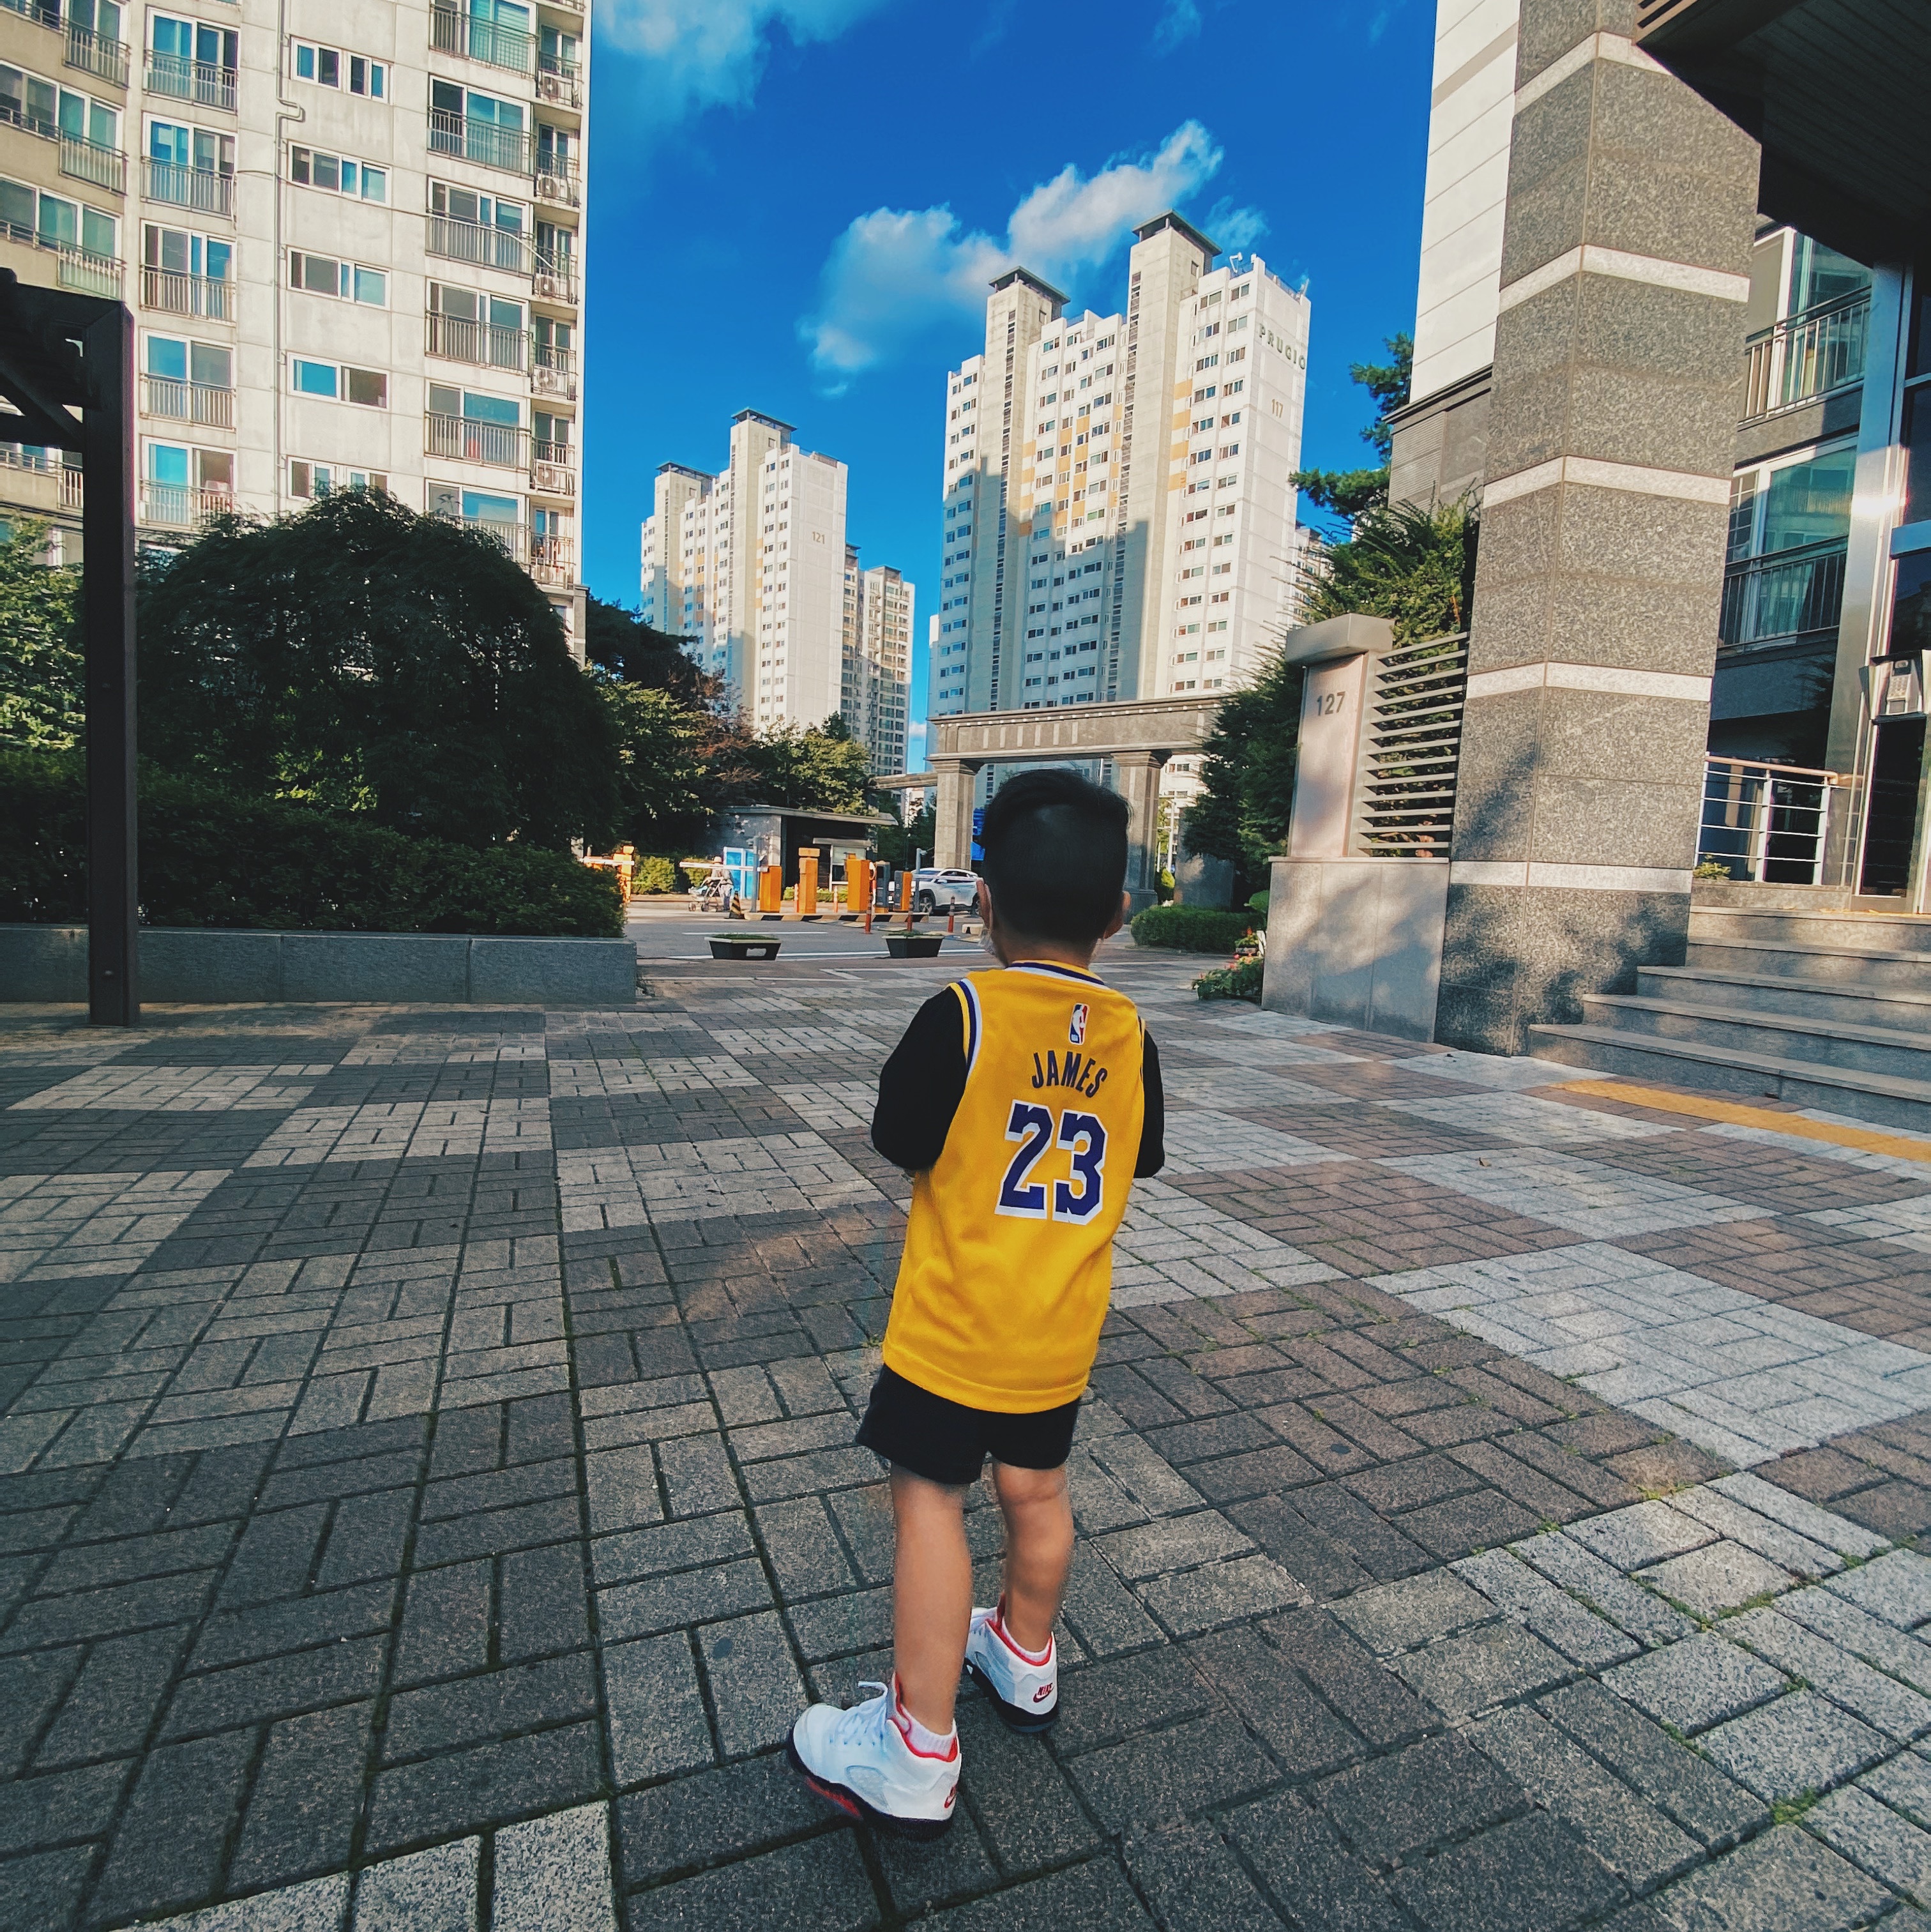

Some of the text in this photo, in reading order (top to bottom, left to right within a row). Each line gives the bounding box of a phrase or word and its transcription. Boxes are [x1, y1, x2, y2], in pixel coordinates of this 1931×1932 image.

[1259, 323, 1306, 370] PRUGIO
[1271, 399, 1284, 418] 117
[812, 531, 825, 544] 121
[1316, 691, 1346, 717] 127
[1031, 1049, 1108, 1098] JAMES
[994, 1099, 1108, 1226] 23
